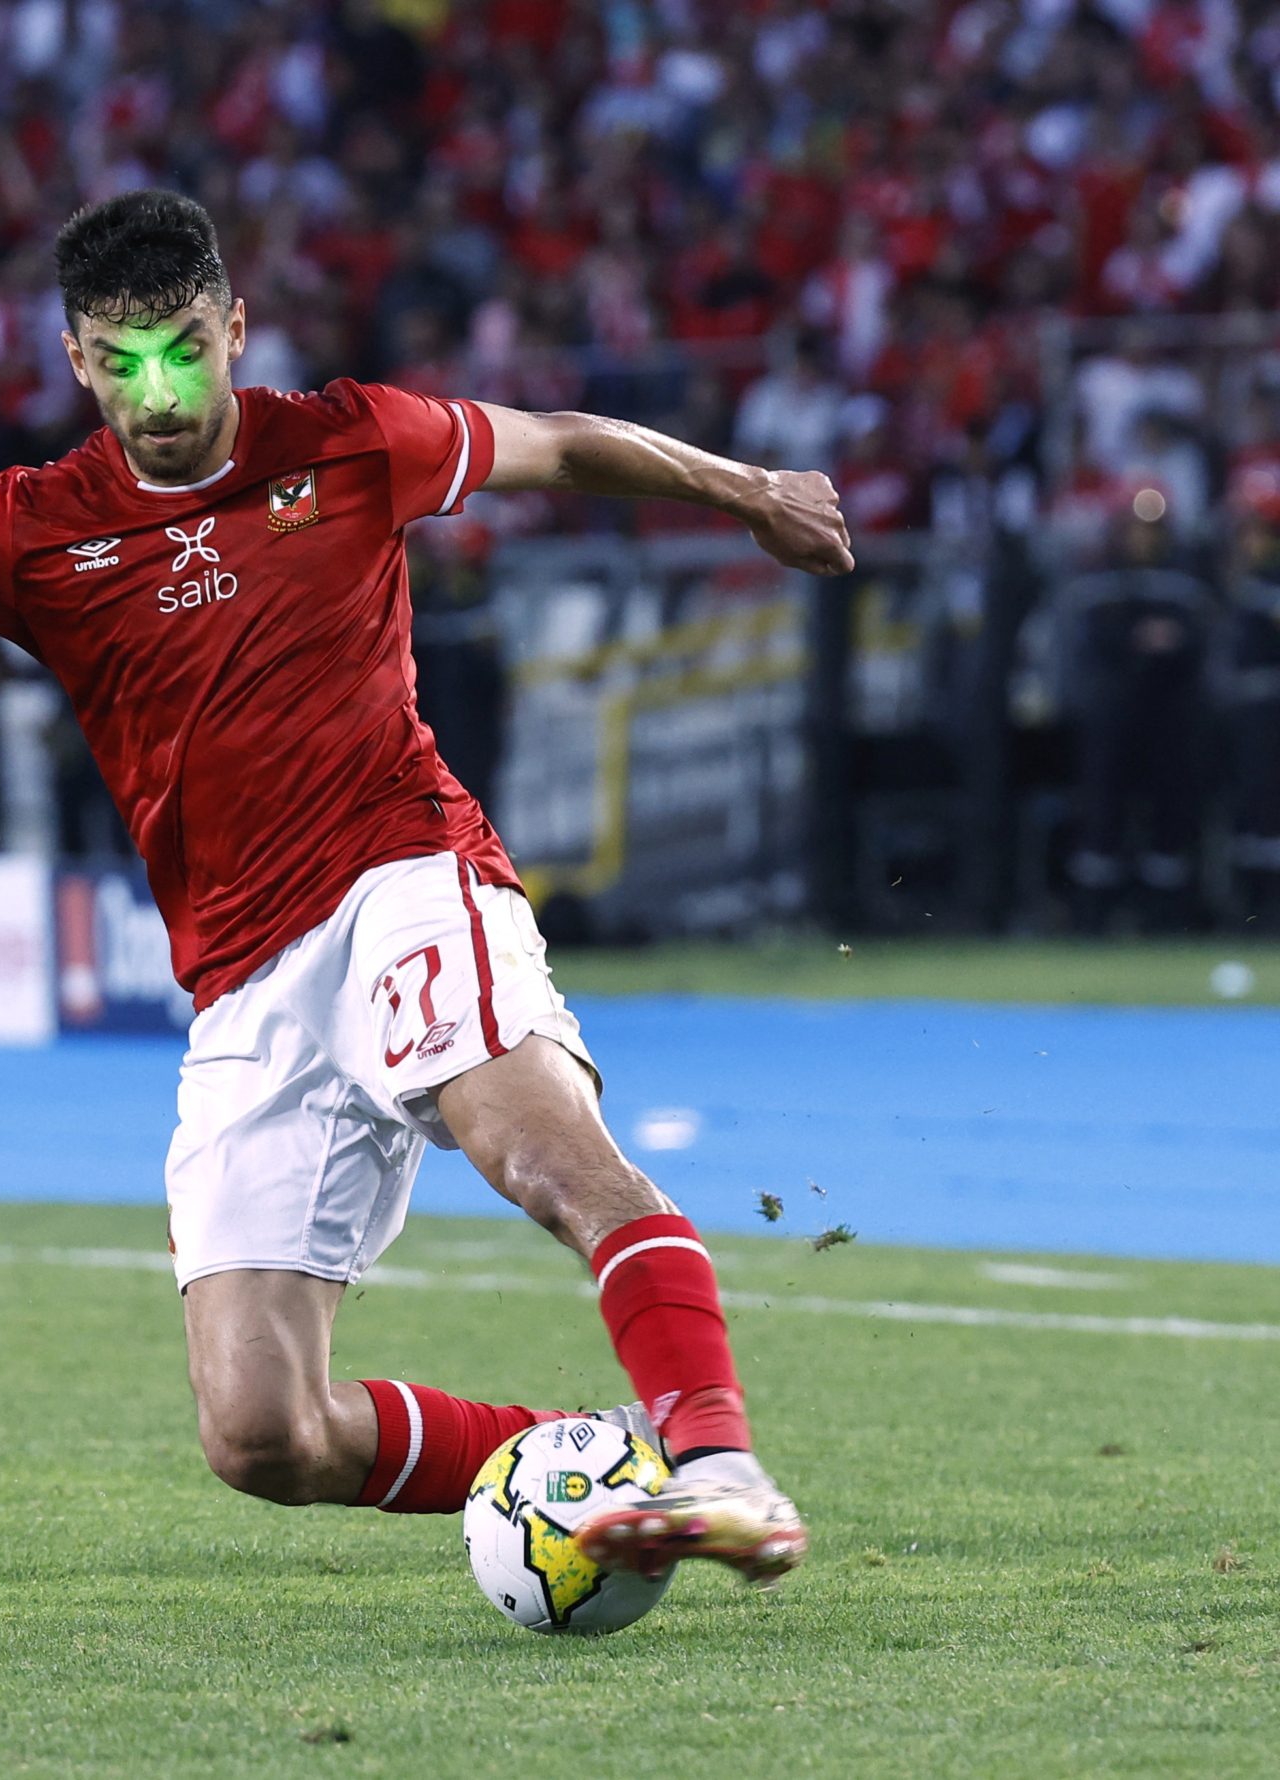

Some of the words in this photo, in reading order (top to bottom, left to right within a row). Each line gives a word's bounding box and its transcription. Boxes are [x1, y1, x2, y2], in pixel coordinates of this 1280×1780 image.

[74, 554, 120, 573] umbro
[157, 567, 239, 614] saib
[417, 1039, 455, 1060] umbro
